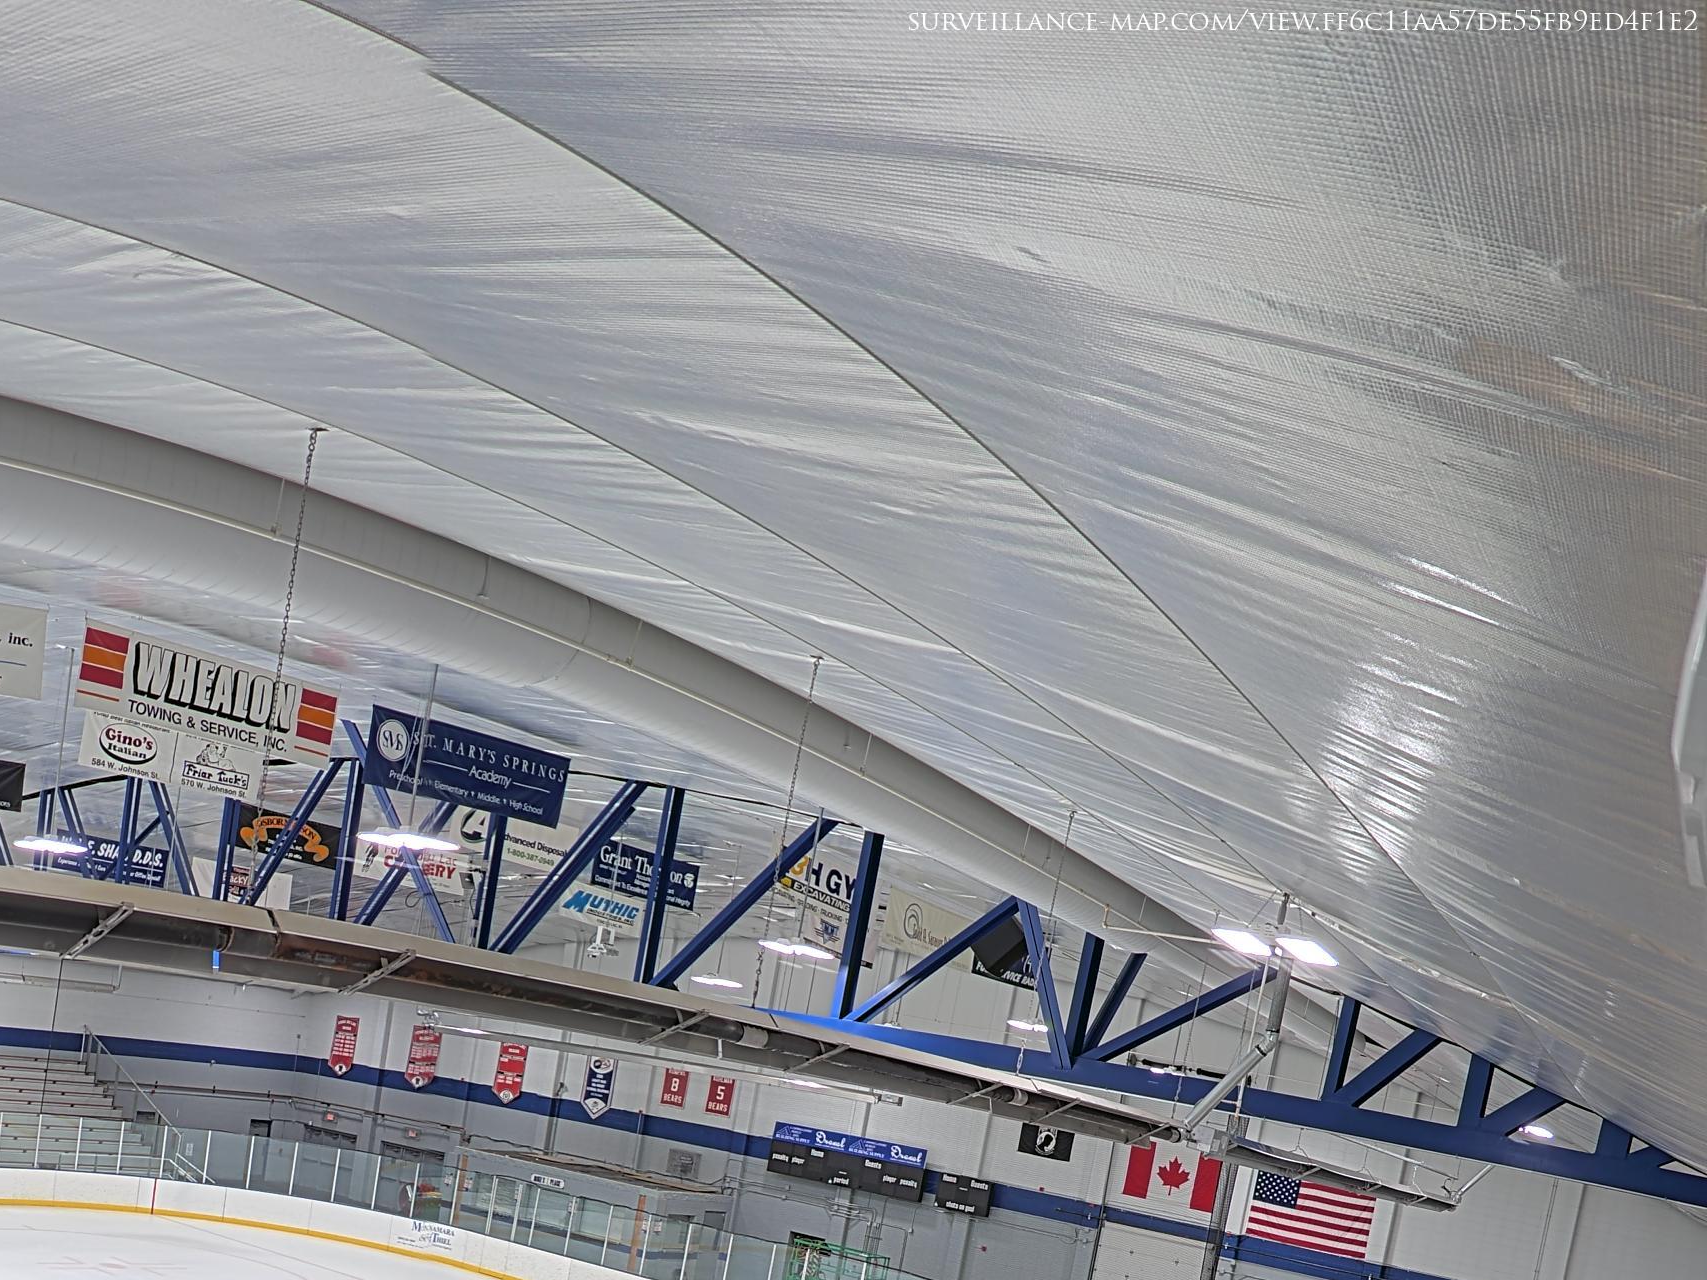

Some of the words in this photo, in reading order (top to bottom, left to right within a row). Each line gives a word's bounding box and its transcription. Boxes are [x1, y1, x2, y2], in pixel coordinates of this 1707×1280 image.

[7, 631, 34, 648] inc.
[133, 640, 297, 734] WHEALON
[127, 698, 183, 726] TOWING
[186, 716, 197, 730] &
[200, 719, 260, 748] SERVICE,
[263, 734, 288, 752] INC.
[104, 726, 154, 751] Gino's
[107, 741, 147, 760] Italian
[442, 738, 497, 764] MARY'S
[502, 754, 566, 783] SPRINGS
[91, 757, 105, 767] 584
[106, 760, 118, 770] W.
[118, 763, 149, 779] Johnson
[149, 769, 161, 780] St.
[185, 765, 213, 782] Friar
[217, 771, 249, 788] Tuck's
[467, 765, 512, 789] Academy
[181, 778, 195, 788] 570
[196, 781, 207, 790] W.
[206, 783, 237, 797] Johnson
[237, 788, 248, 798] St.
[434, 779, 469, 797] Elementary
[476, 791, 501, 805] Middle
[508, 799, 523, 811] High
[522, 803, 543, 816] School
[503, 833, 535, 849] dvanced
[600, 845, 632, 870] Grant
[635, 854, 683, 885] Thoon
[670, 1078, 680, 1092] 8
[715, 1085, 726, 1100] 5
[707, 1101, 729, 1113] BEARS
